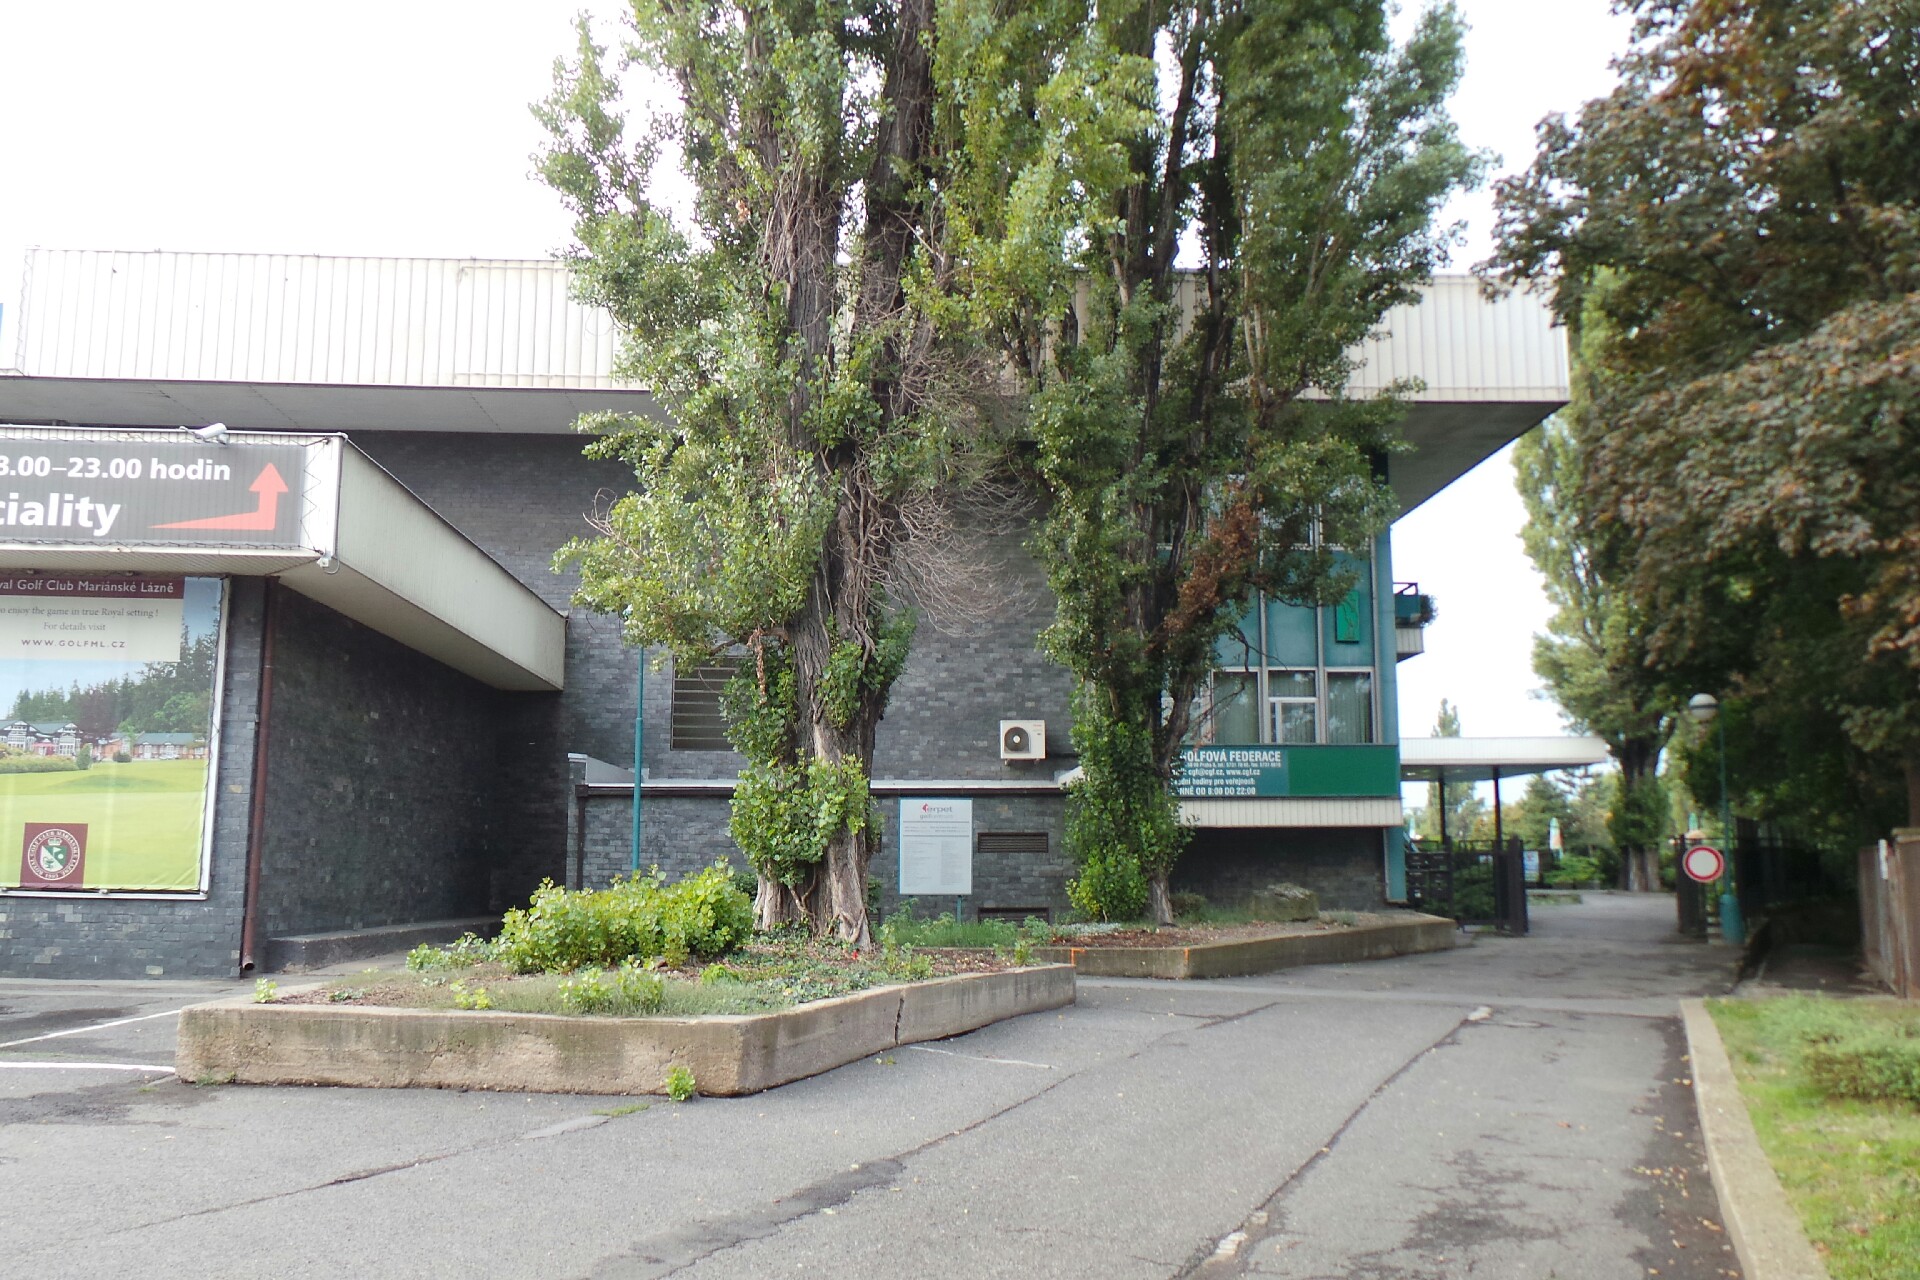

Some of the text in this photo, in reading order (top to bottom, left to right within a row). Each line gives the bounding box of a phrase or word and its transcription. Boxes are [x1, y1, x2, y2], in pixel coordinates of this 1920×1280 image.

[150, 458, 230, 480] hodin
[0, 492, 121, 536] iality
[17, 579, 43, 590] Golf
[46, 580, 74, 591] Club
[78, 581, 137, 592] Mariánské
[140, 582, 174, 593] Lázně
[32, 606, 44, 615] the
[47, 609, 69, 617] game
[82, 608, 98, 616] true
[101, 608, 124, 618] Royal
[126, 609, 154, 619] setting
[43, 621, 57, 630] For
[59, 622, 86, 630] details
[21, 639, 125, 648] WWW.GOLFML.CZ
[1229, 750, 1281, 762] FEDERACE
[1195, 787, 1206, 795] OD
[1224, 787, 1235, 795] DO
[1236, 786, 1256, 795] 22:00
